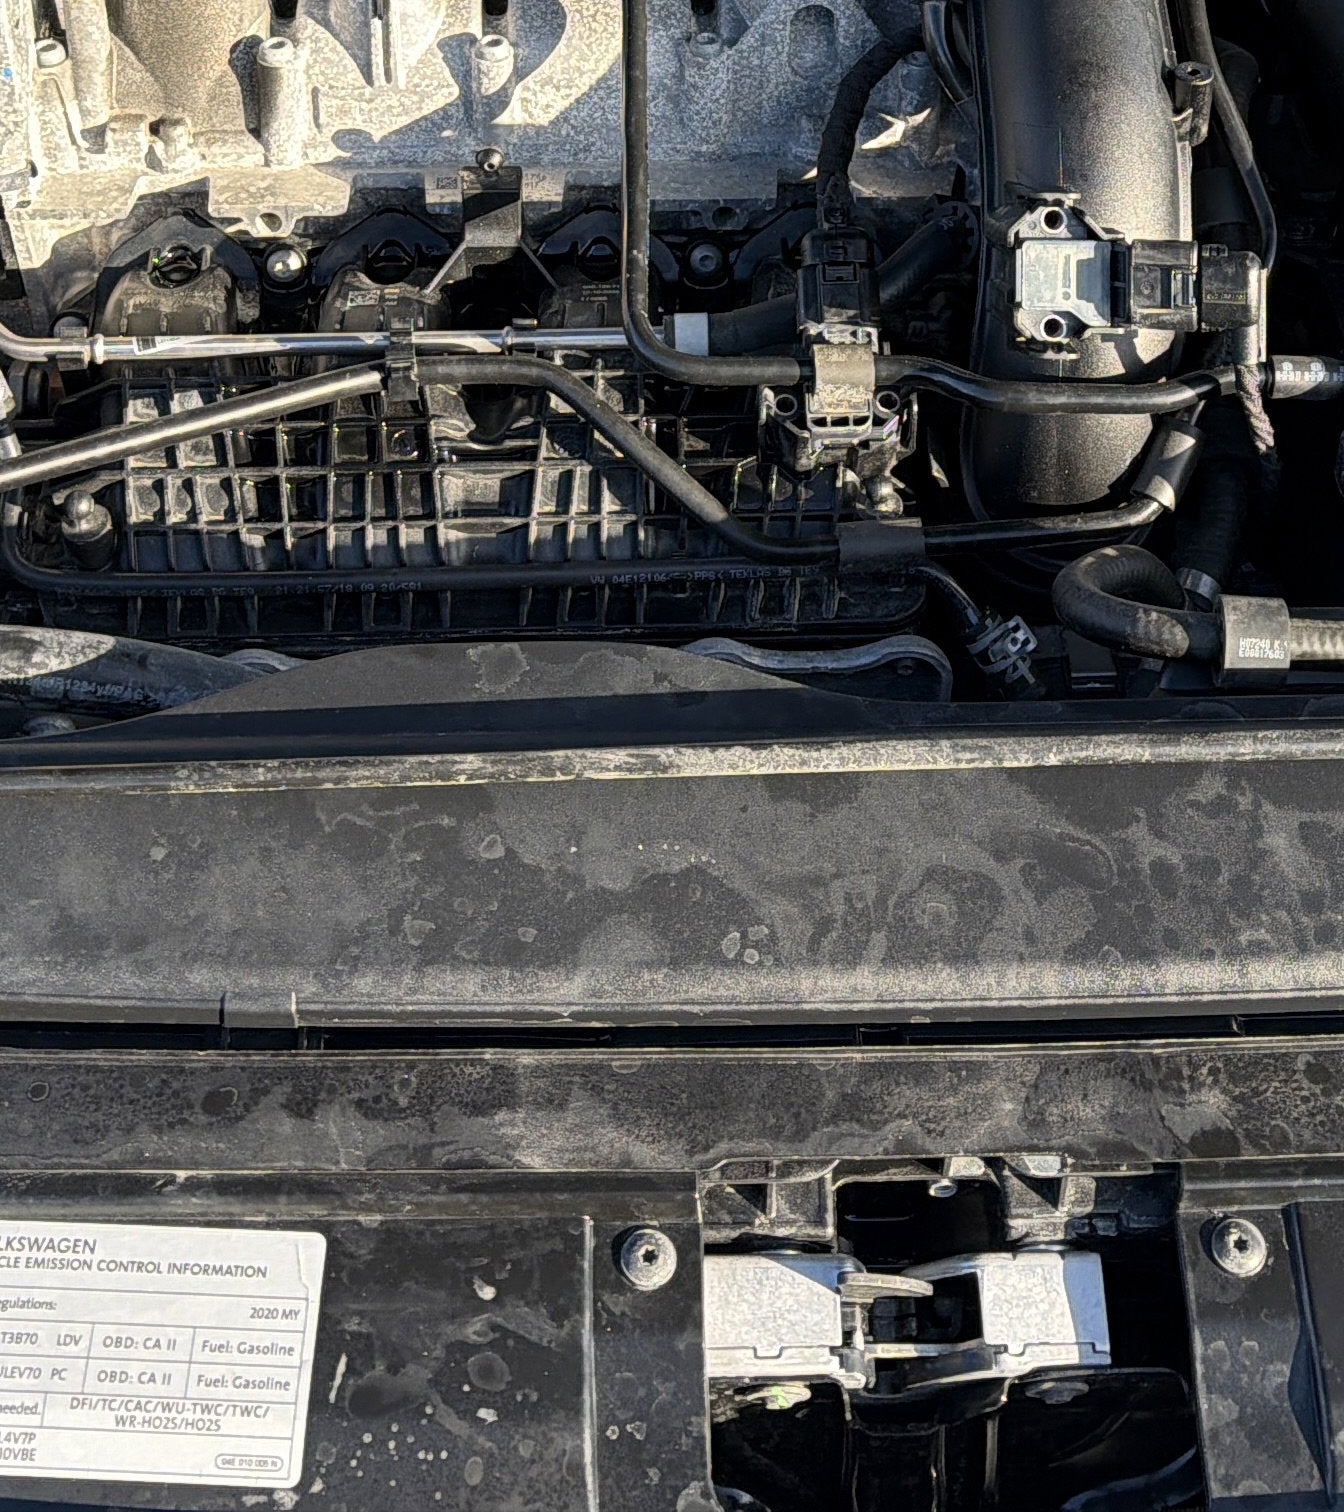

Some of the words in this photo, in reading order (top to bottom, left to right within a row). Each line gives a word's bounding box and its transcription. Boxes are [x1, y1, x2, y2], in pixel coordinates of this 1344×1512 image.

[24, 1256, 94, 1272] EMISSION
[96, 1259, 163, 1275] CONTROL
[166, 1262, 268, 1278] INFORMATION
[249, 1307, 279, 1320] 2020
[281, 1308, 301, 1321] MY
[0, 1331, 38, 1345] T3B70
[57, 1333, 83, 1347] LDV
[102, 1336, 139, 1350] OBD:
[143, 1337, 162, 1351] CA
[166, 1338, 177, 1351] II
[201, 1340, 233, 1354] Fuel:
[237, 1341, 295, 1356] Gasoline
[50, 1367, 68, 1381] PC
[97, 1370, 134, 1384] OBD:
[137, 1371, 156, 1385] CA
[161, 1373, 172, 1386] II
[196, 1374, 229, 1388] Fuel:
[232, 1376, 291, 1391] Gasoline
[69, 1397, 271, 1419] DFI/TC/CAC/WU-TWC/TWC/
[114, 1414, 222, 1432] WR-HO2S/HO2S
